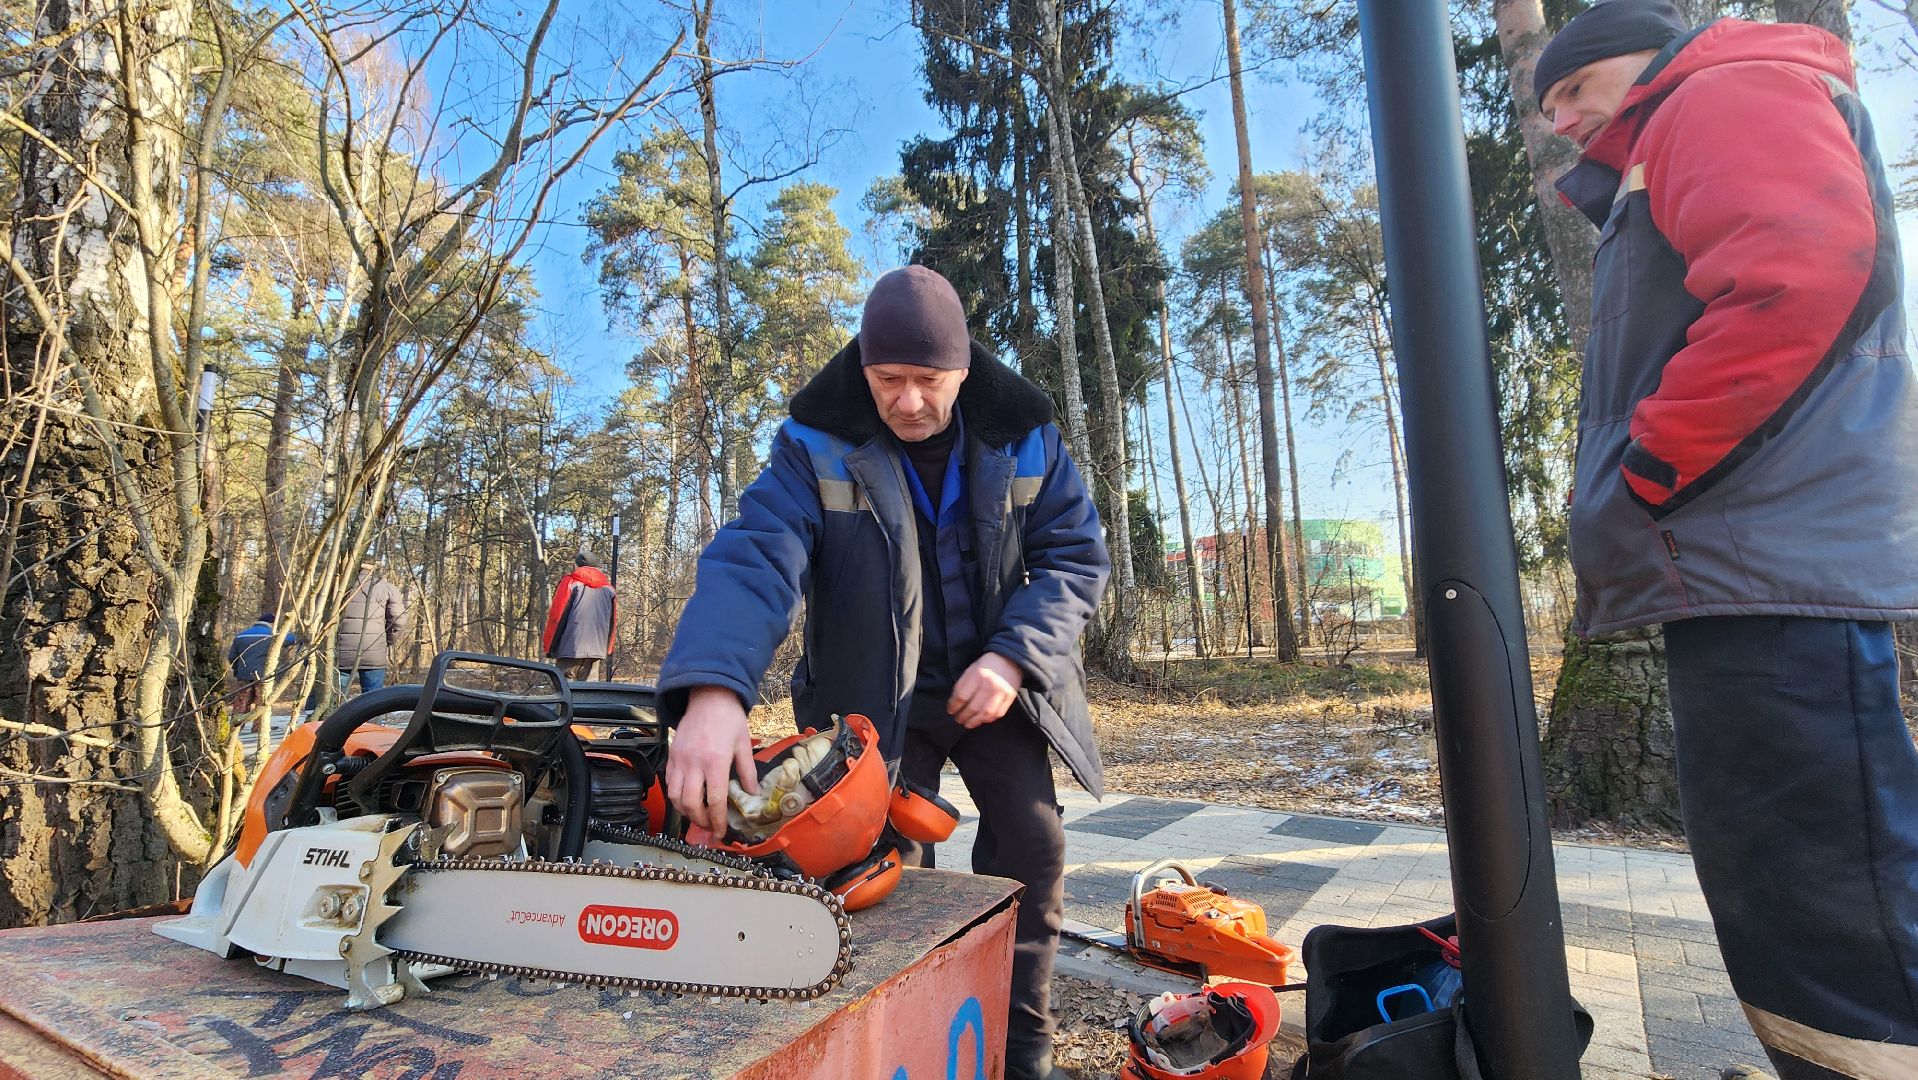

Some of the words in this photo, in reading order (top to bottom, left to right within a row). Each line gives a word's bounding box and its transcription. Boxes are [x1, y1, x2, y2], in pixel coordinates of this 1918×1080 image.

[303, 847, 350, 868] STIHL
[510, 910, 566, 928] AdvanceCut
[585, 912, 674, 942] OREGON
